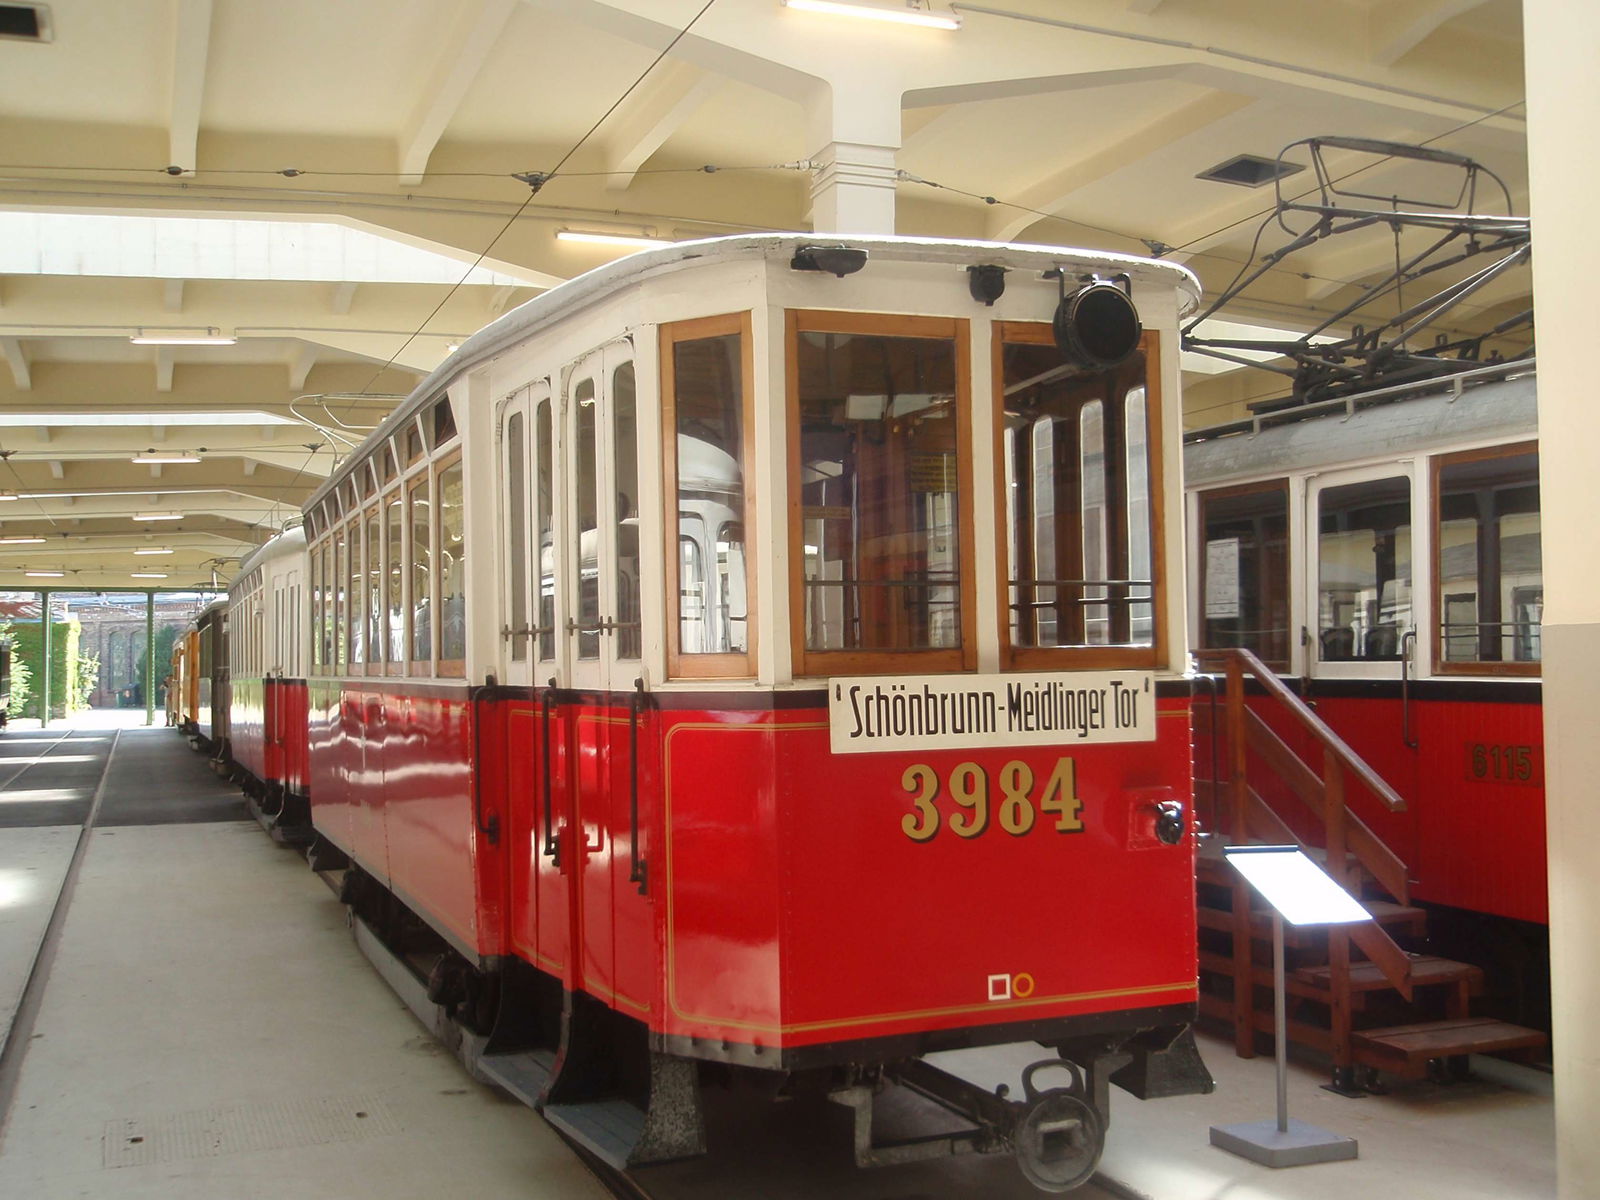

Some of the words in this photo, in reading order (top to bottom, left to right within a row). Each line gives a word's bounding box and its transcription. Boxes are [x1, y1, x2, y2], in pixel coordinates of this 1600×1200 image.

[1110, 680, 1139, 729] Tor
[1472, 744, 1532, 781] 6115
[901, 757, 1083, 842] 3984
